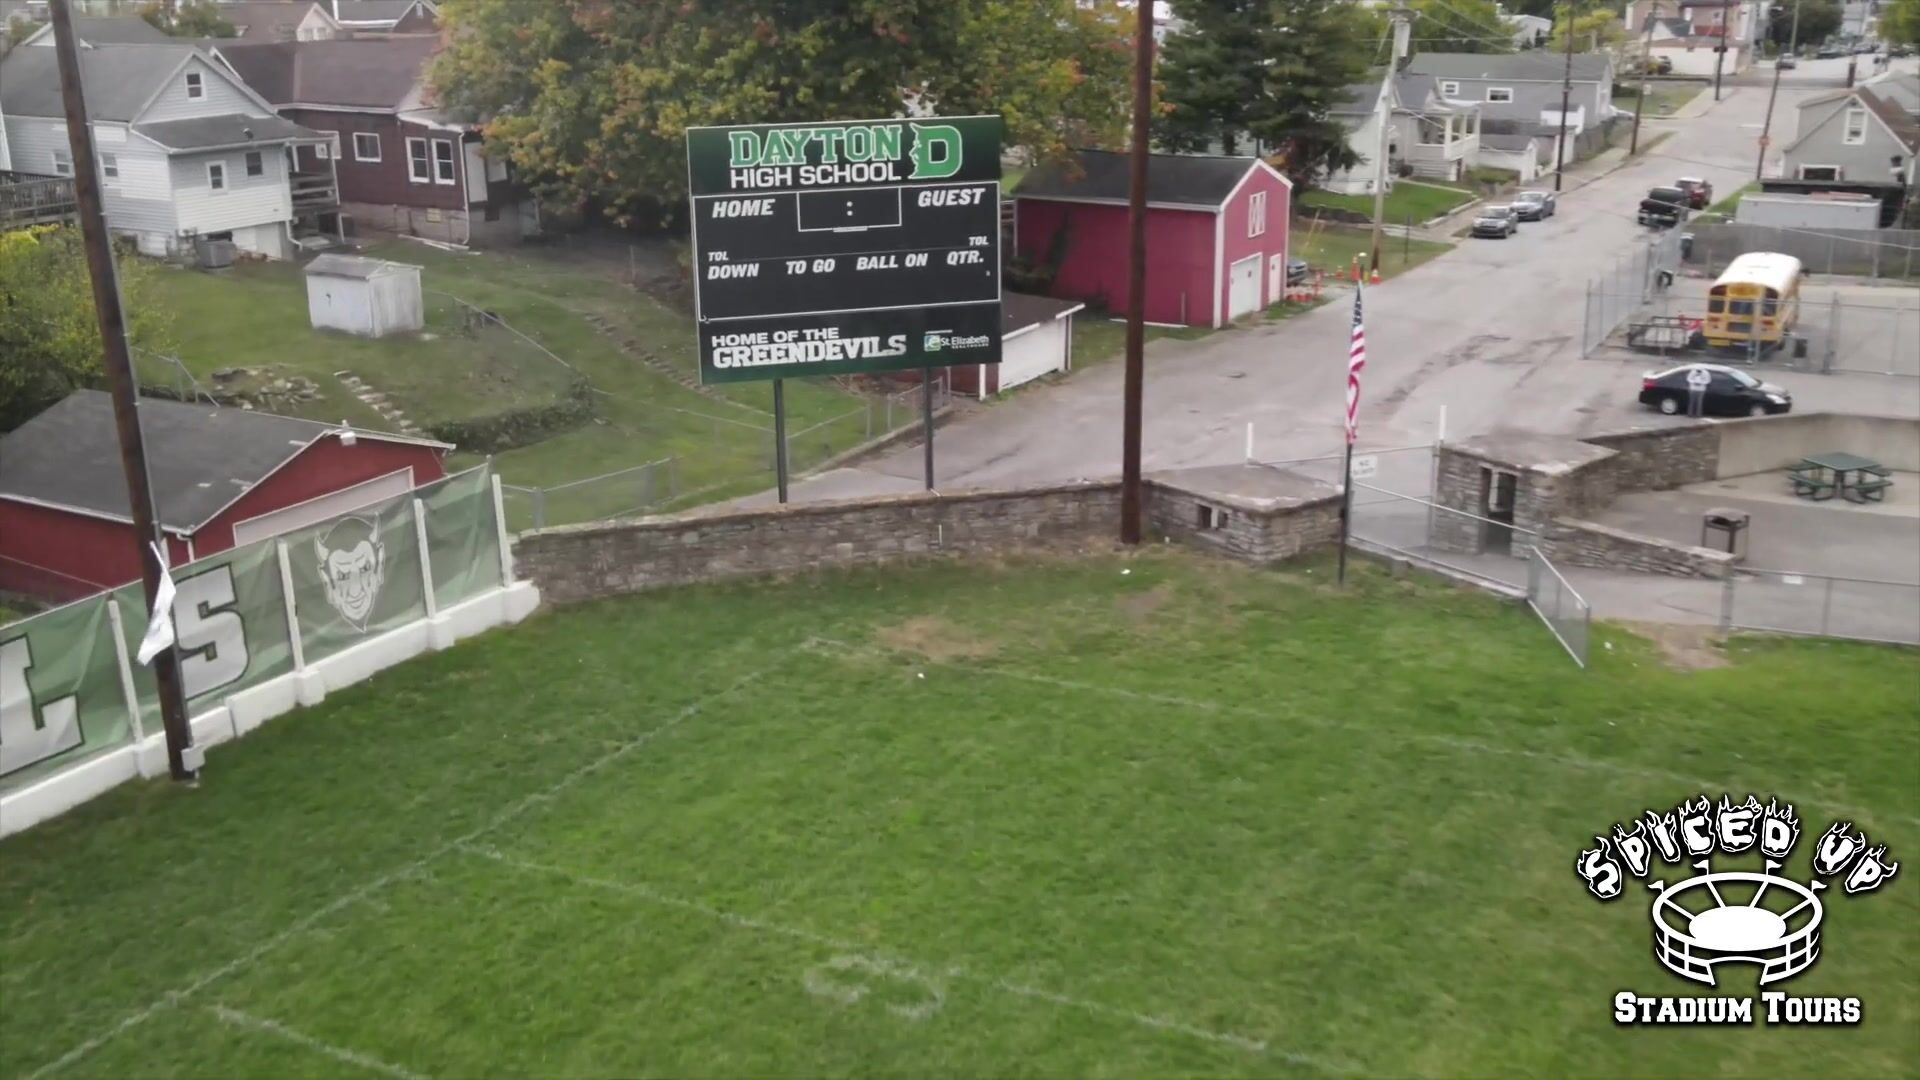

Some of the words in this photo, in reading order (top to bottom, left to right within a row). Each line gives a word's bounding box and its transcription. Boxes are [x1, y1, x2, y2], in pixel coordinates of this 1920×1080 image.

[728, 125, 902, 168] DAYTON
[730, 167, 793, 189] HIGH
[799, 162, 902, 185] SCHOOL
[918, 188, 986, 207] GUEST
[712, 199, 775, 218] HOME
[969, 235, 989, 247] TOL
[707, 251, 729, 262] TOL
[856, 255, 899, 270] BALL
[904, 252, 928, 267] ON
[946, 250, 984, 265] QTR.
[707, 263, 760, 280] DOWN
[786, 260, 807, 274] TO
[812, 258, 836, 273] GO
[711, 333, 767, 347] HOME
[772, 331, 798, 343] OF
[803, 327, 839, 341] THE
[712, 335, 907, 369] GREENDEVILS
